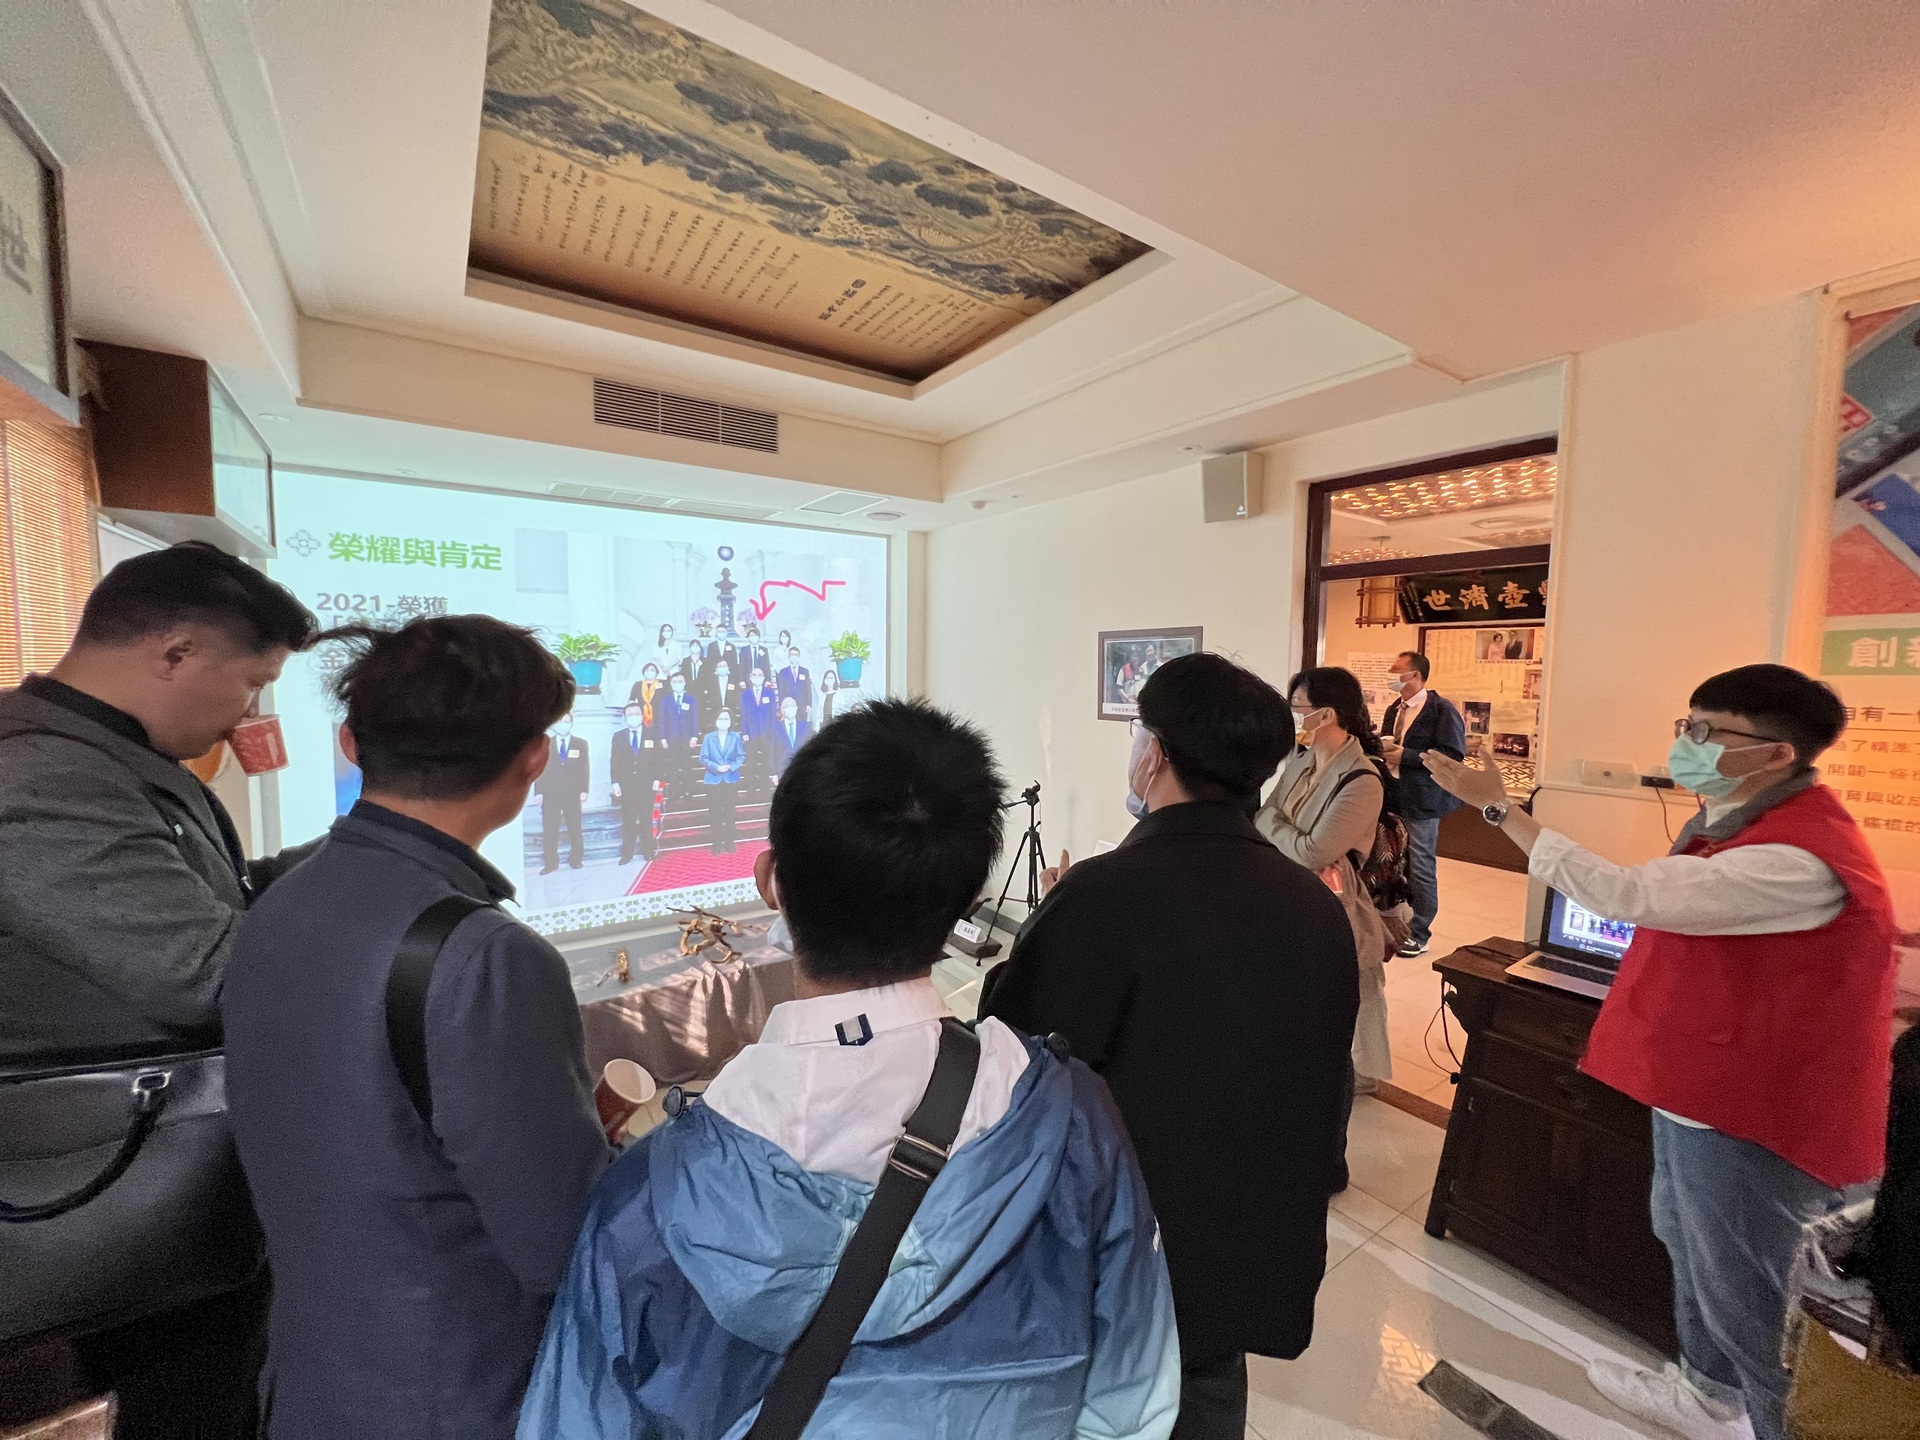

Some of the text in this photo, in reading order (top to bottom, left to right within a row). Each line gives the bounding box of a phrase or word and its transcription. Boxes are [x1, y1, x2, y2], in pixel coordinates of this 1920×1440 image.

[328, 531, 503, 571] 榮耀與肯定
[316, 592, 448, 615] 2021-榮獲
[1848, 635, 1920, 668] 創
